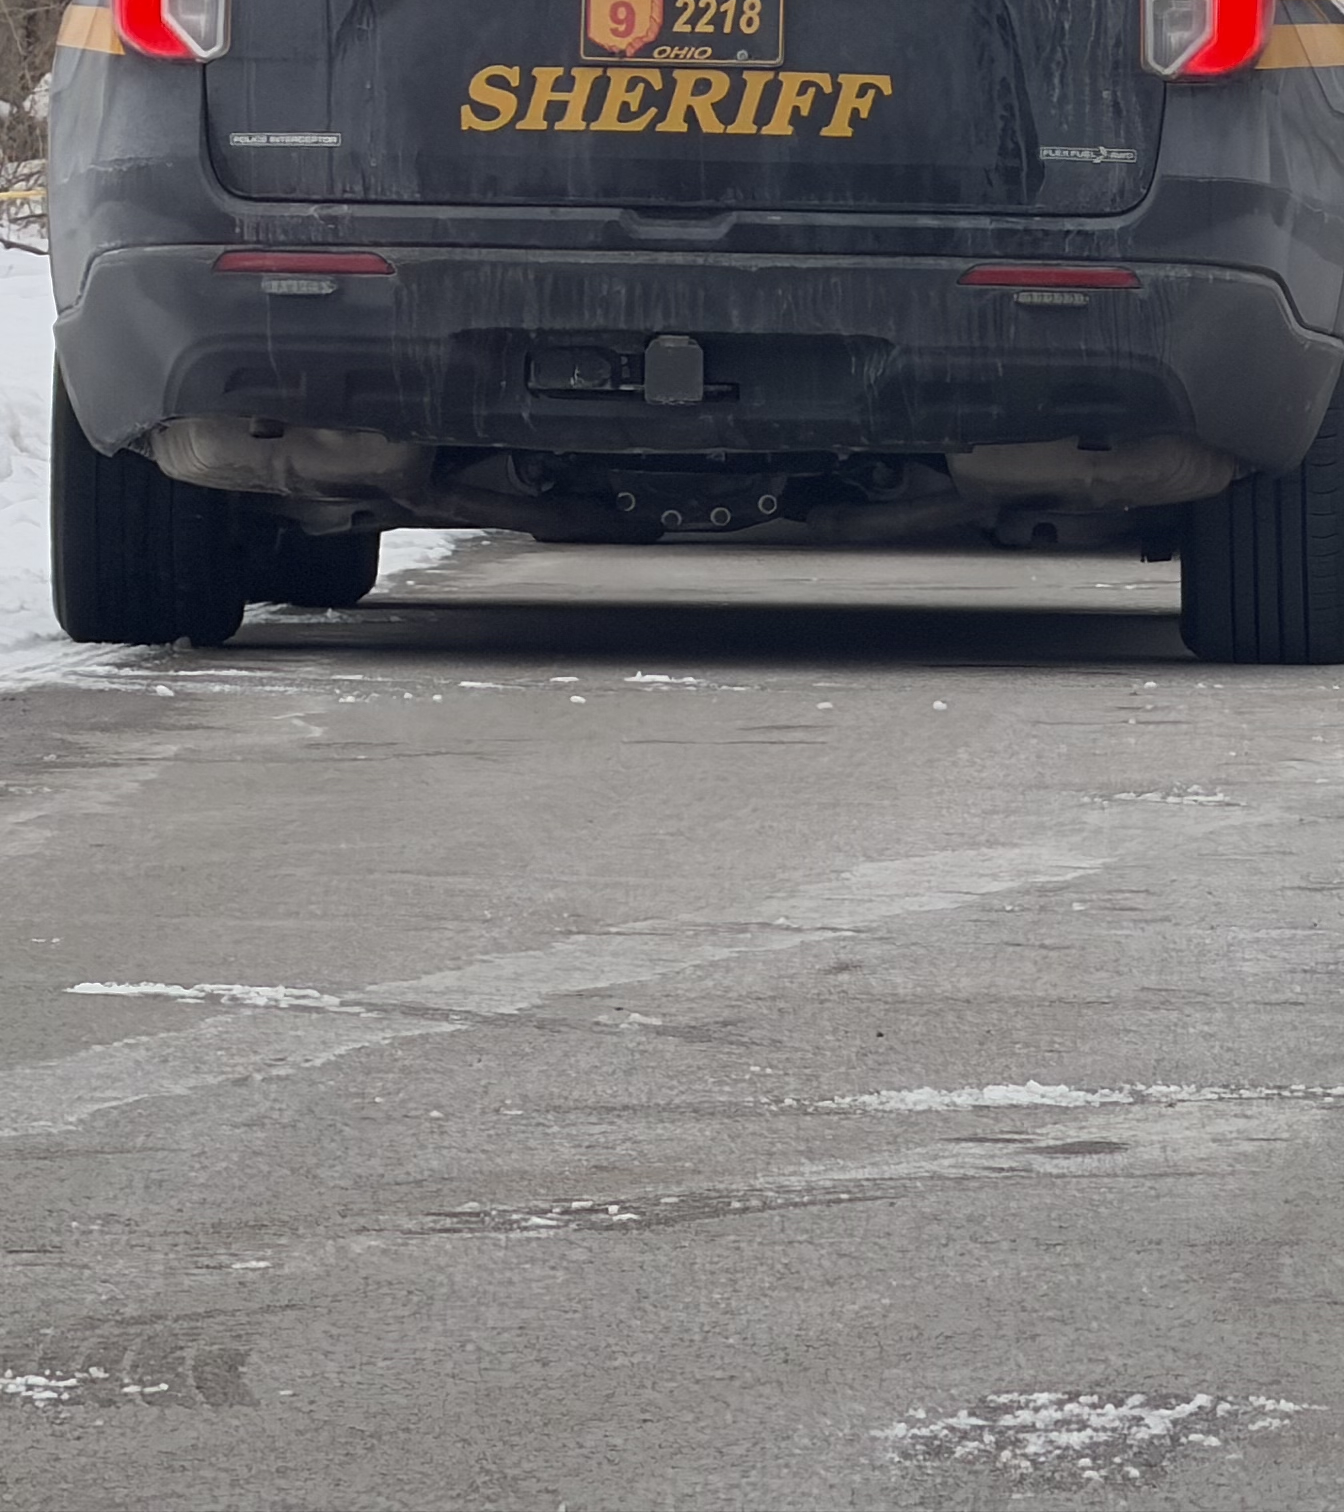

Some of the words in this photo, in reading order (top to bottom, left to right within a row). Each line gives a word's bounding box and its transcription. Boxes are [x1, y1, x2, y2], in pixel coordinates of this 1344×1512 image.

[609, 0, 636, 38] 9
[652, 45, 712, 59] OHIO
[460, 64, 892, 137] SHERIFF
